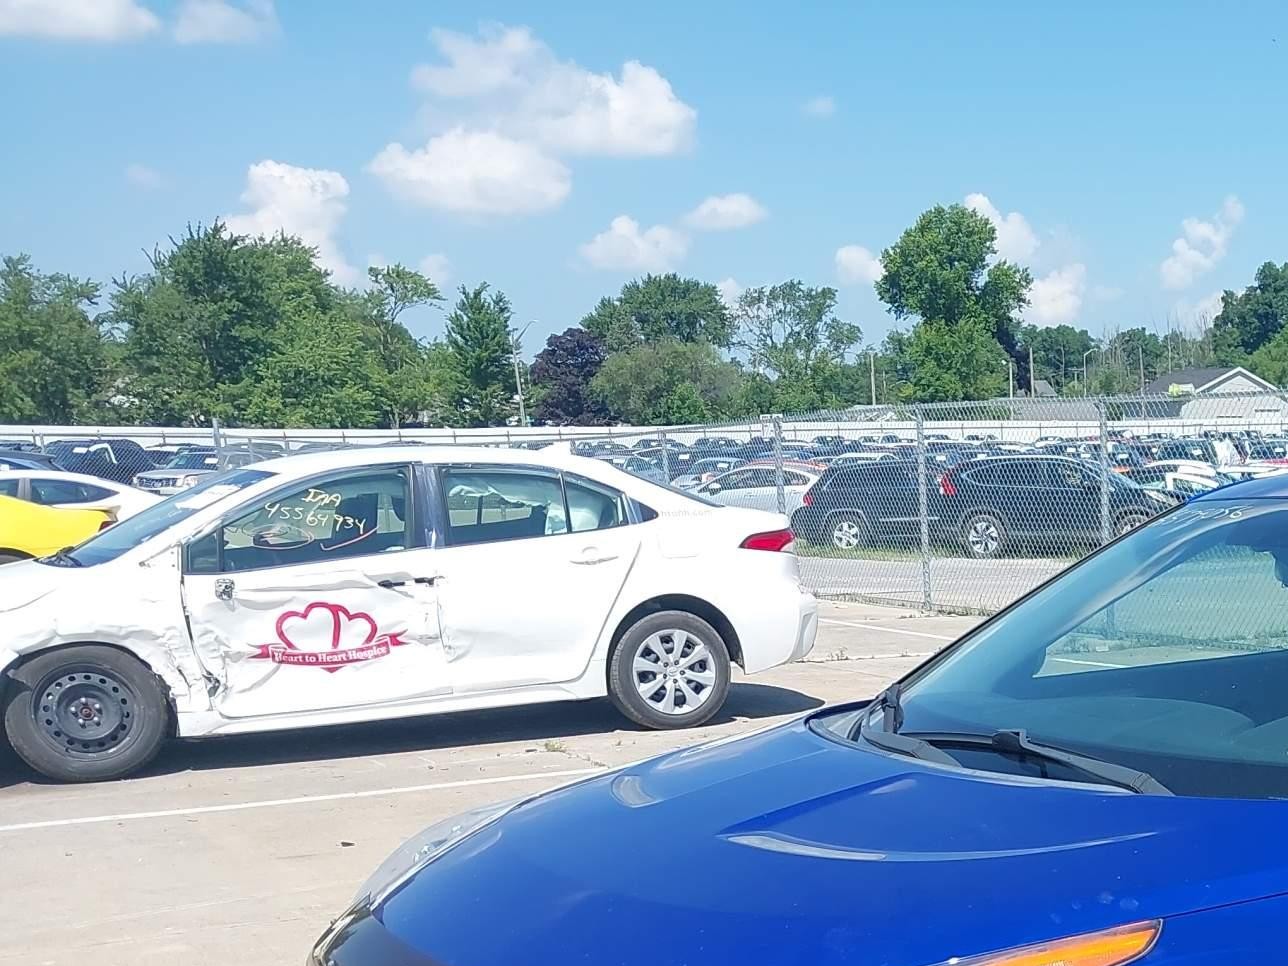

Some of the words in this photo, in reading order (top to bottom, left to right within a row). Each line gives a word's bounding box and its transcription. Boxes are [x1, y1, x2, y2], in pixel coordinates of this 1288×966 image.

[274, 651, 304, 663] Heart
[305, 654, 317, 663] to
[318, 651, 348, 663] Heart
[348, 645, 388, 661] Hospice
